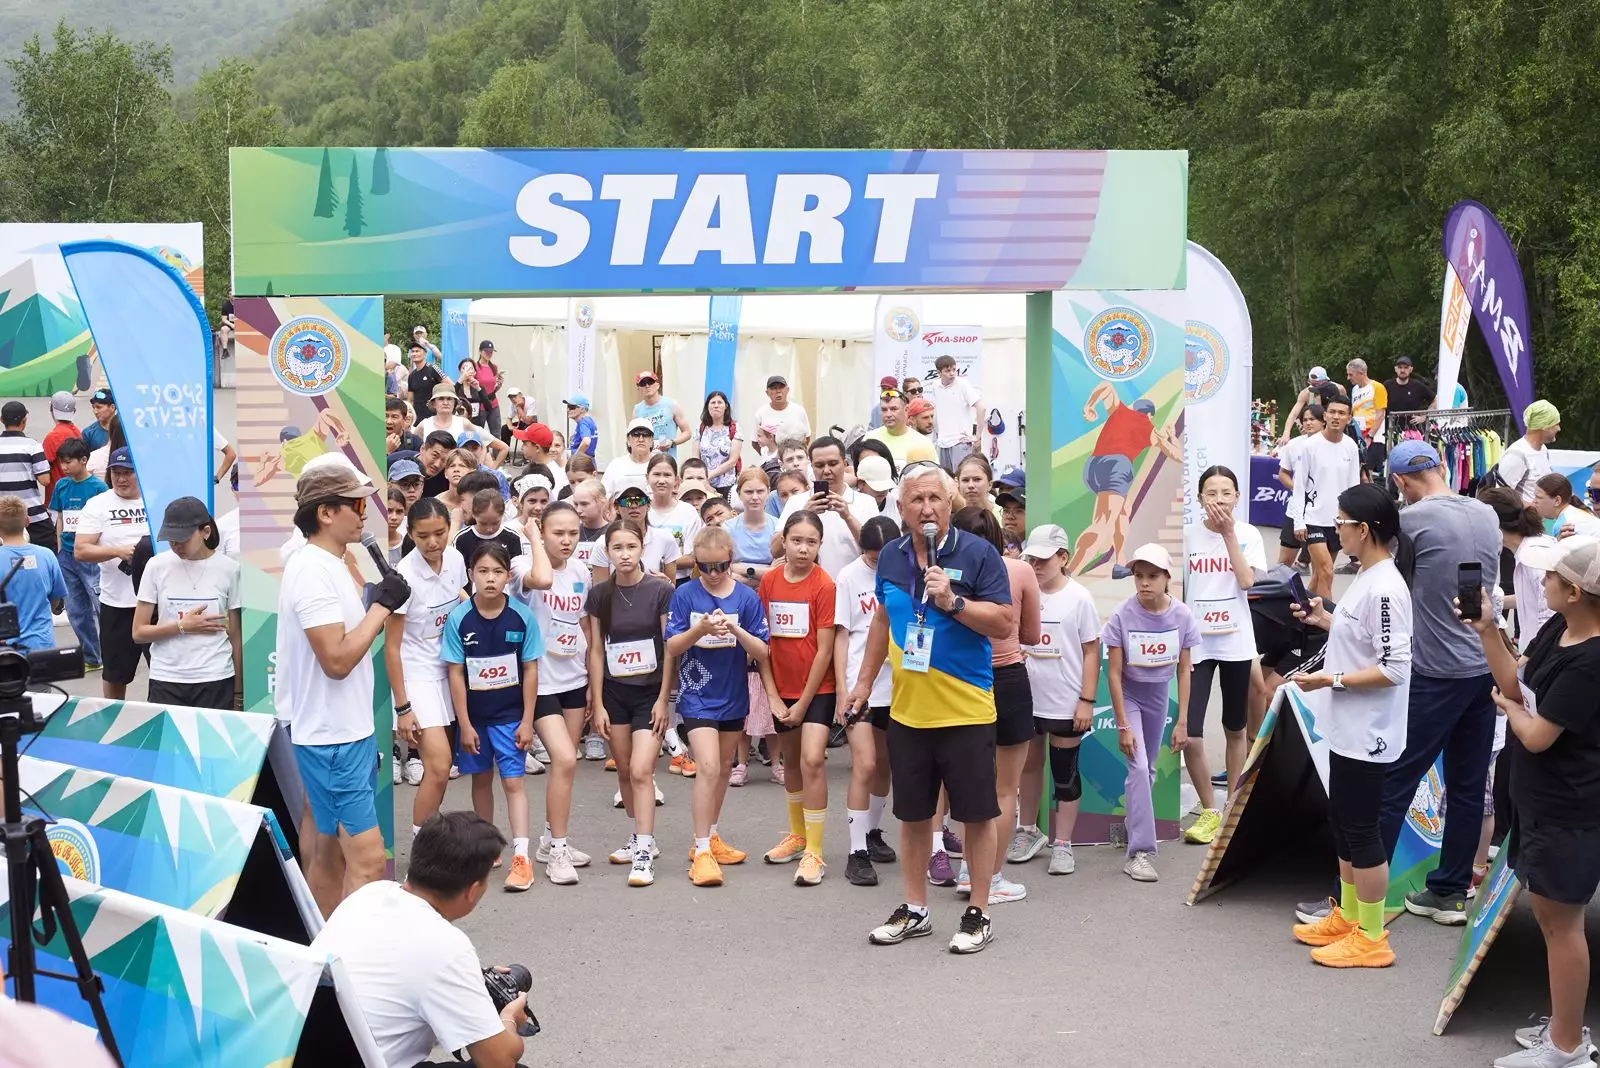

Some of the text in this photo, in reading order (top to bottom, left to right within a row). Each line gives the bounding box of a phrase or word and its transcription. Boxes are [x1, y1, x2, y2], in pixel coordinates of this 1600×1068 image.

[509, 173, 940, 268] START
[578, 550, 591, 560] 21
[1189, 557, 1234, 575] MINI
[775, 613, 794, 625] 391
[1203, 610, 1230, 623] 476
[1381, 596, 1391, 634] STEPPE
[1139, 643, 1167, 655] 149
[617, 651, 642, 665] 471
[478, 665, 508, 680] 492
